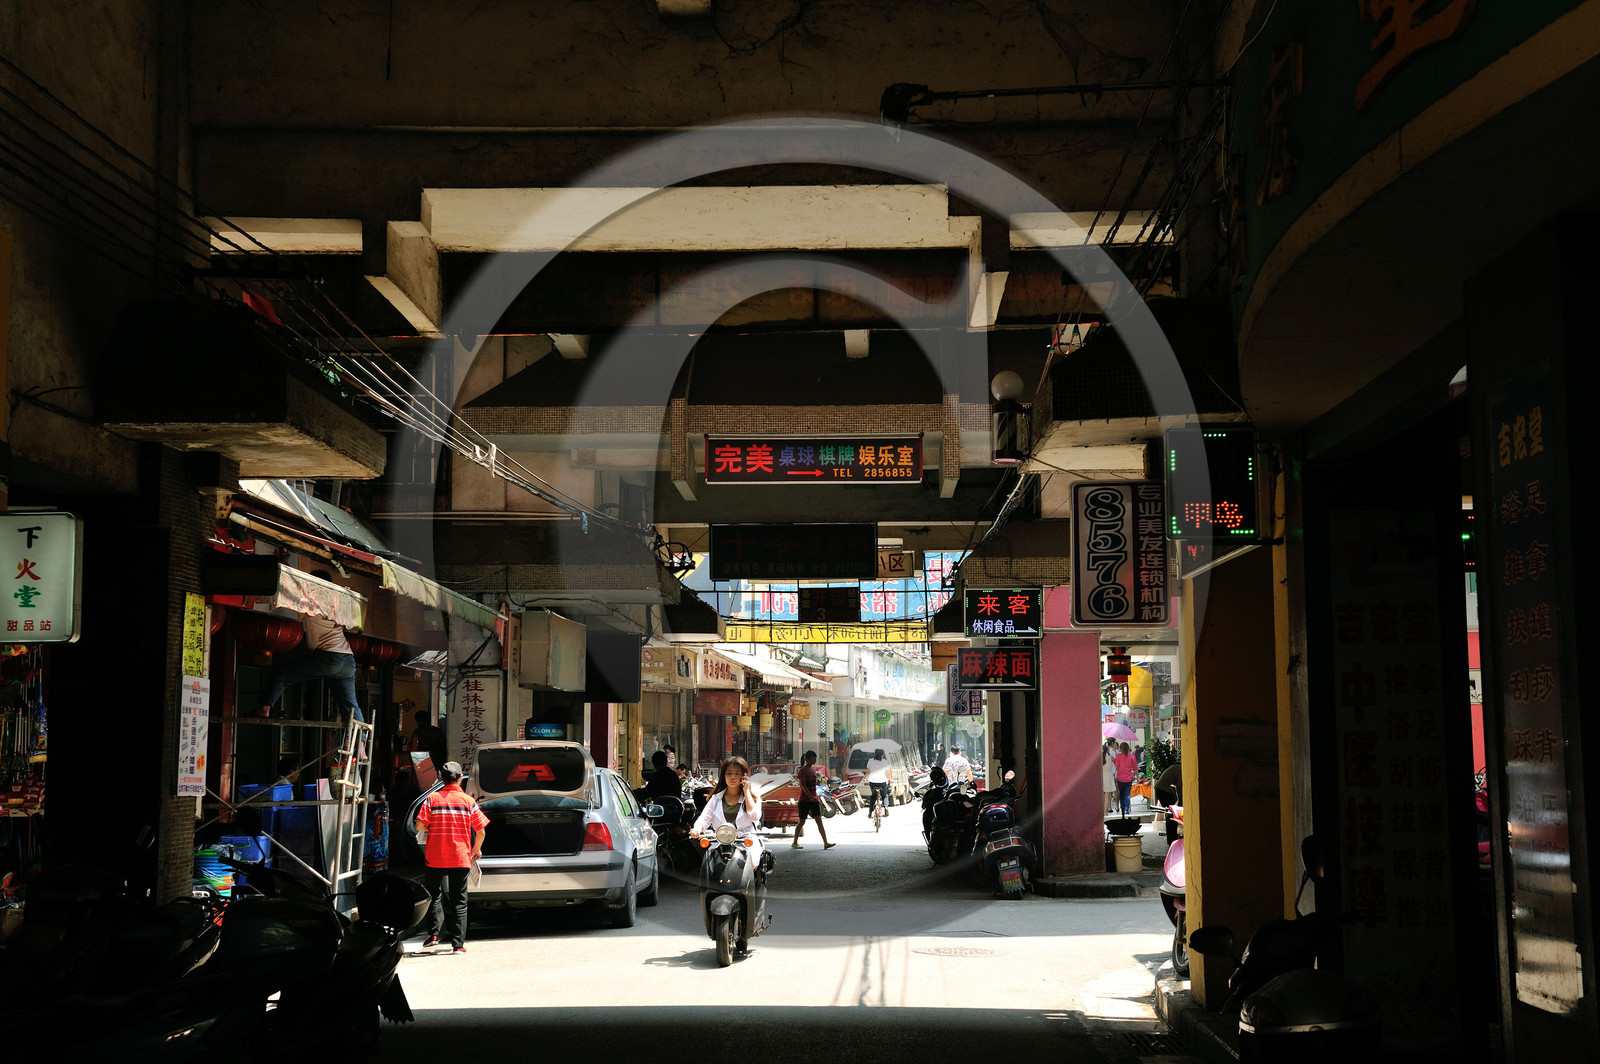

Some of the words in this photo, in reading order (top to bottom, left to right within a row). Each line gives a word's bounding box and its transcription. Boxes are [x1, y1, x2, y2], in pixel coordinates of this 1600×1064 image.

[714, 444, 914, 474] 完美桌球棋牌娱乐室
[833, 468, 853, 478] TEL
[864, 468, 913, 478] 2856855
[1500, 479, 1547, 525] 浴足
[13, 526, 42, 608] 下火堂
[880, 553, 905, 572] 区
[1084, 487, 1129, 618] 8576
[1138, 484, 1164, 620] 专业美发连锁机构
[1503, 539, 1550, 586] 推拿
[977, 594, 1031, 616] 来客
[7, 620, 52, 632] 甜品站
[972, 619, 1015, 634] 休闲食品
[1506, 603, 1552, 647] 拔罐
[961, 650, 1032, 679] 麻辣面
[1384, 663, 1438, 697] 推拿
[1508, 663, 1556, 705] 刮痧
[1340, 662, 1389, 930] 中医按摩
